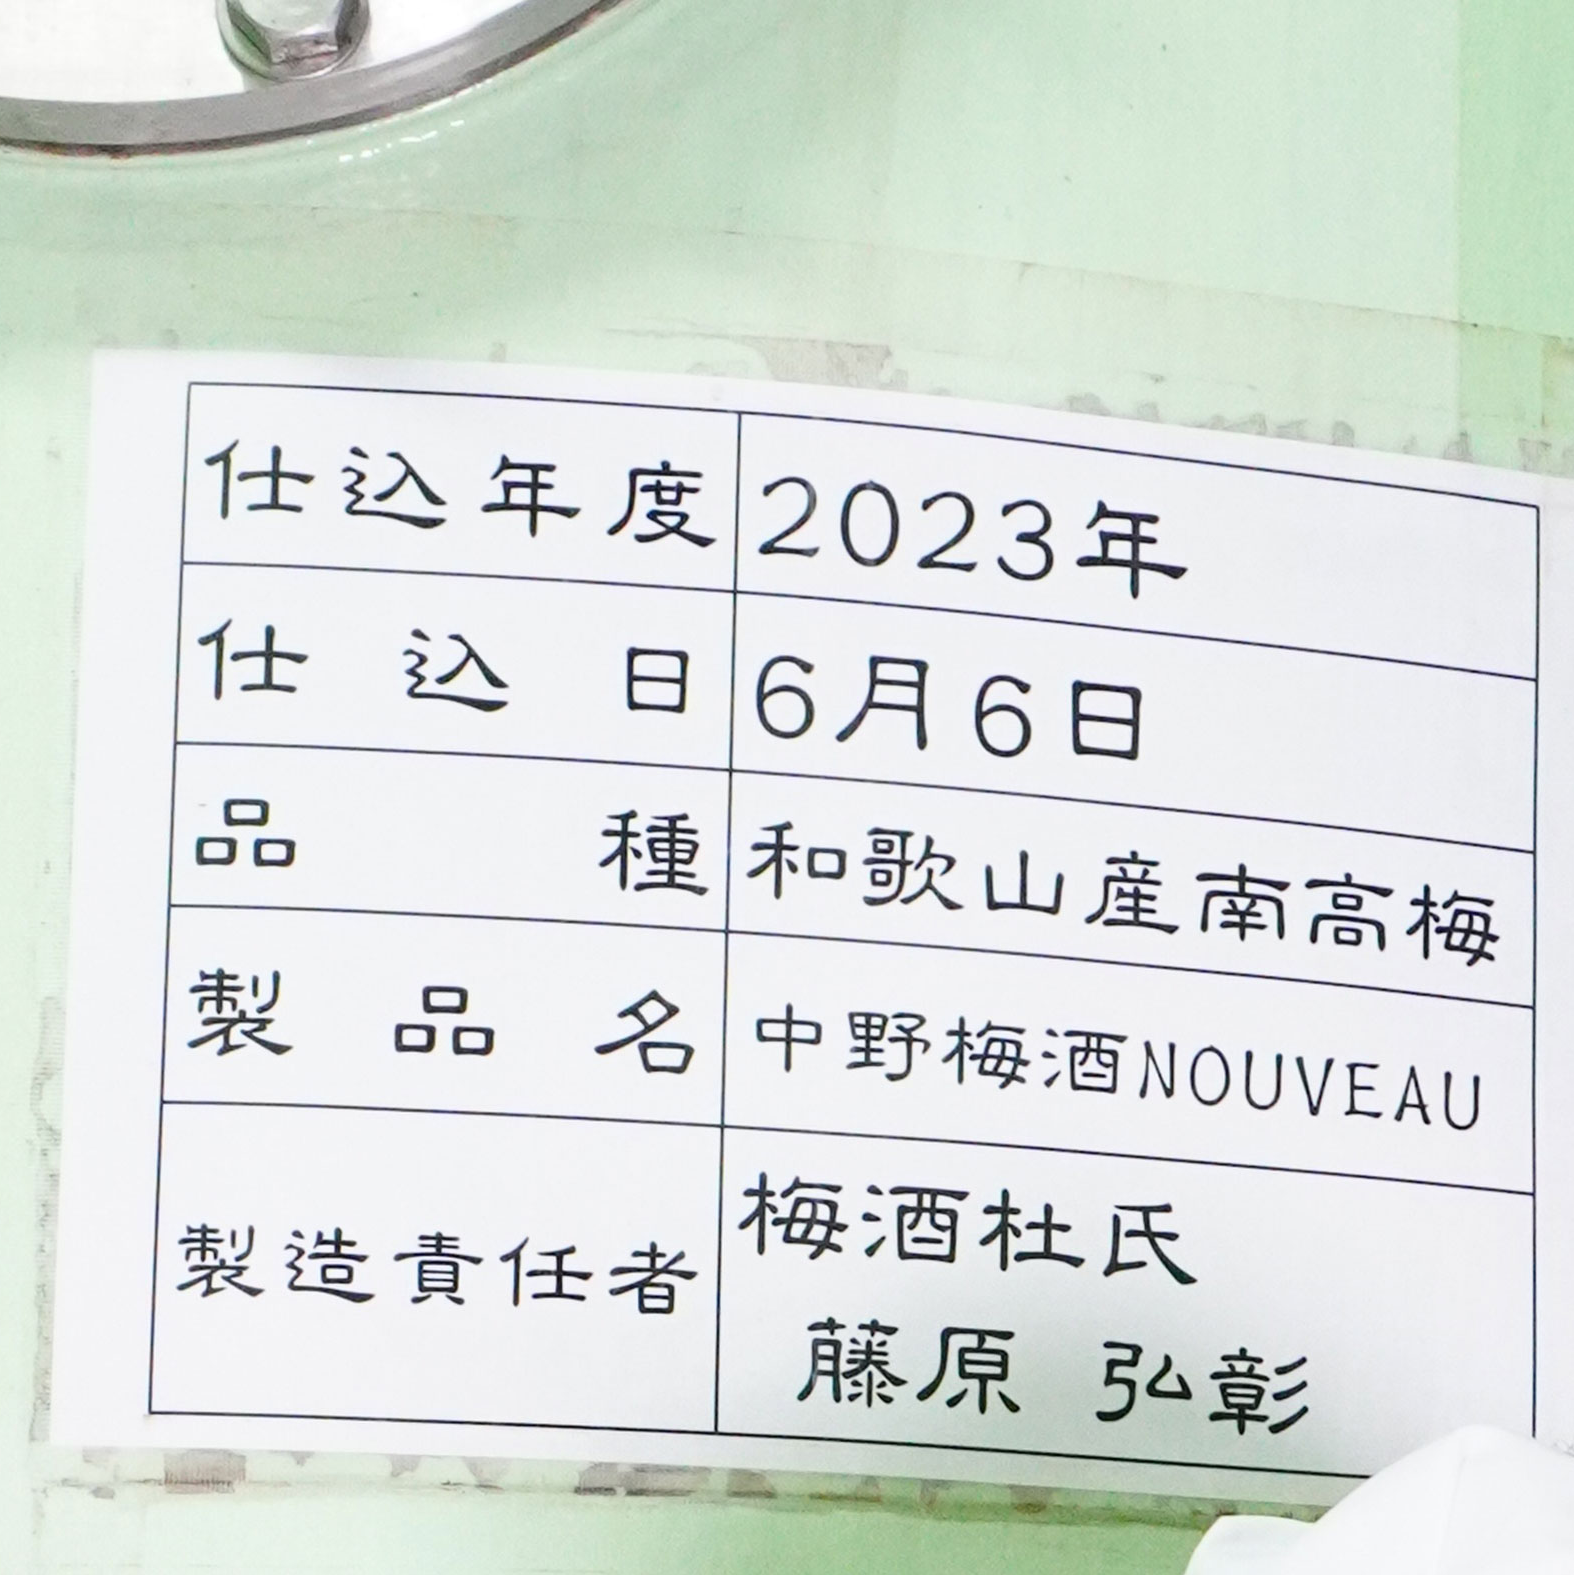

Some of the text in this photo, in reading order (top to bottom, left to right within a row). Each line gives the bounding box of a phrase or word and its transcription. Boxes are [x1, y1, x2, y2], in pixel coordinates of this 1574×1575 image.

[203, 439, 717, 549] 仕込年度
[757, 475, 1189, 601] 2023年
[755, 654, 1143, 762] 6月6日
[745, 820, 1501, 968] 和歌山産南高梅
[175, 1222, 699, 1316] 製造責任者
[737, 1170, 1199, 1287] 梅酒杜氏
[795, 1315, 1310, 1437] 藤原 弘彰
